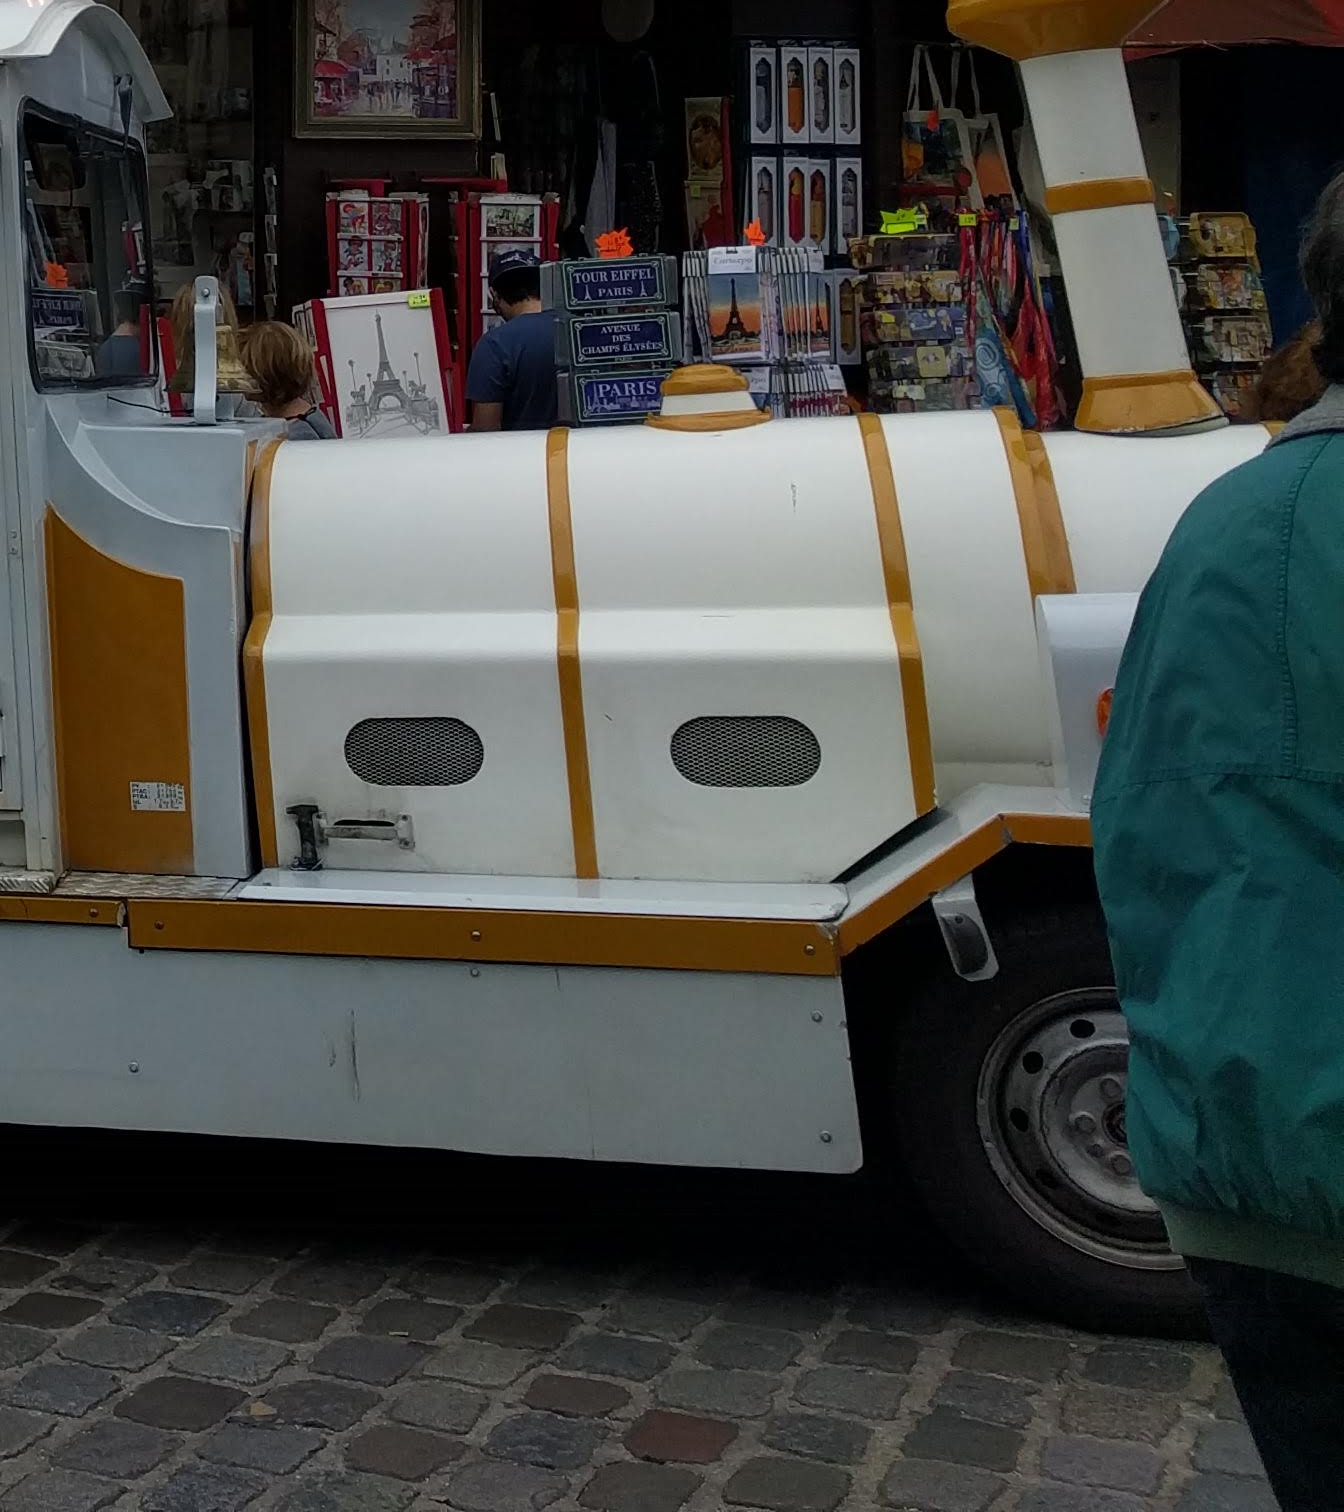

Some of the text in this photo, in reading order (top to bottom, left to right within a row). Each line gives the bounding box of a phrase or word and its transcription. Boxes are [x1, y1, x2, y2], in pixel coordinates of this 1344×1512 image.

[572, 268, 655, 284] TOUR EIFFEL
[597, 286, 634, 297] PARIS
[600, 323, 641, 334] AVENUE
[612, 334, 632, 343] DES
[581, 340, 663, 355] CHAMPS ÉLYSÉES
[598, 380, 657, 398] PARIS
